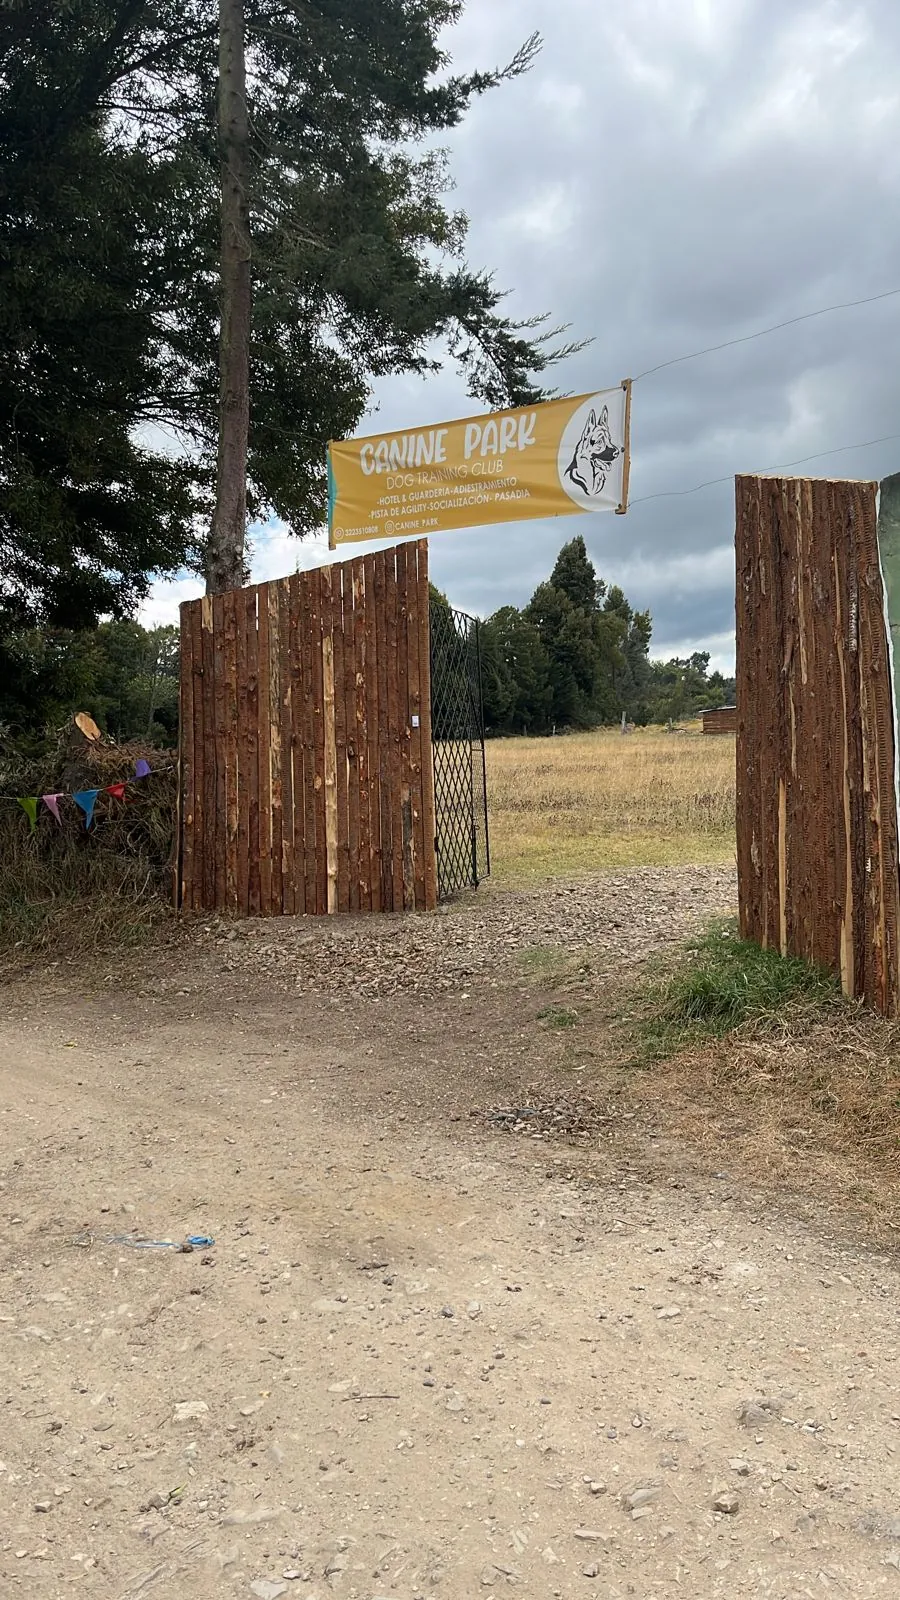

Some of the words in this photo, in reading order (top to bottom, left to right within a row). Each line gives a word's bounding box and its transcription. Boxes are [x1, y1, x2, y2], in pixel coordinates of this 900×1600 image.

[360, 429, 448, 476] CANINE
[464, 412, 537, 460] PARK
[386, 473, 414, 490] DOG
[417, 465, 467, 485] TRAINING
[471, 459, 504, 476] CLUB
[390, 506, 400, 517] DE
